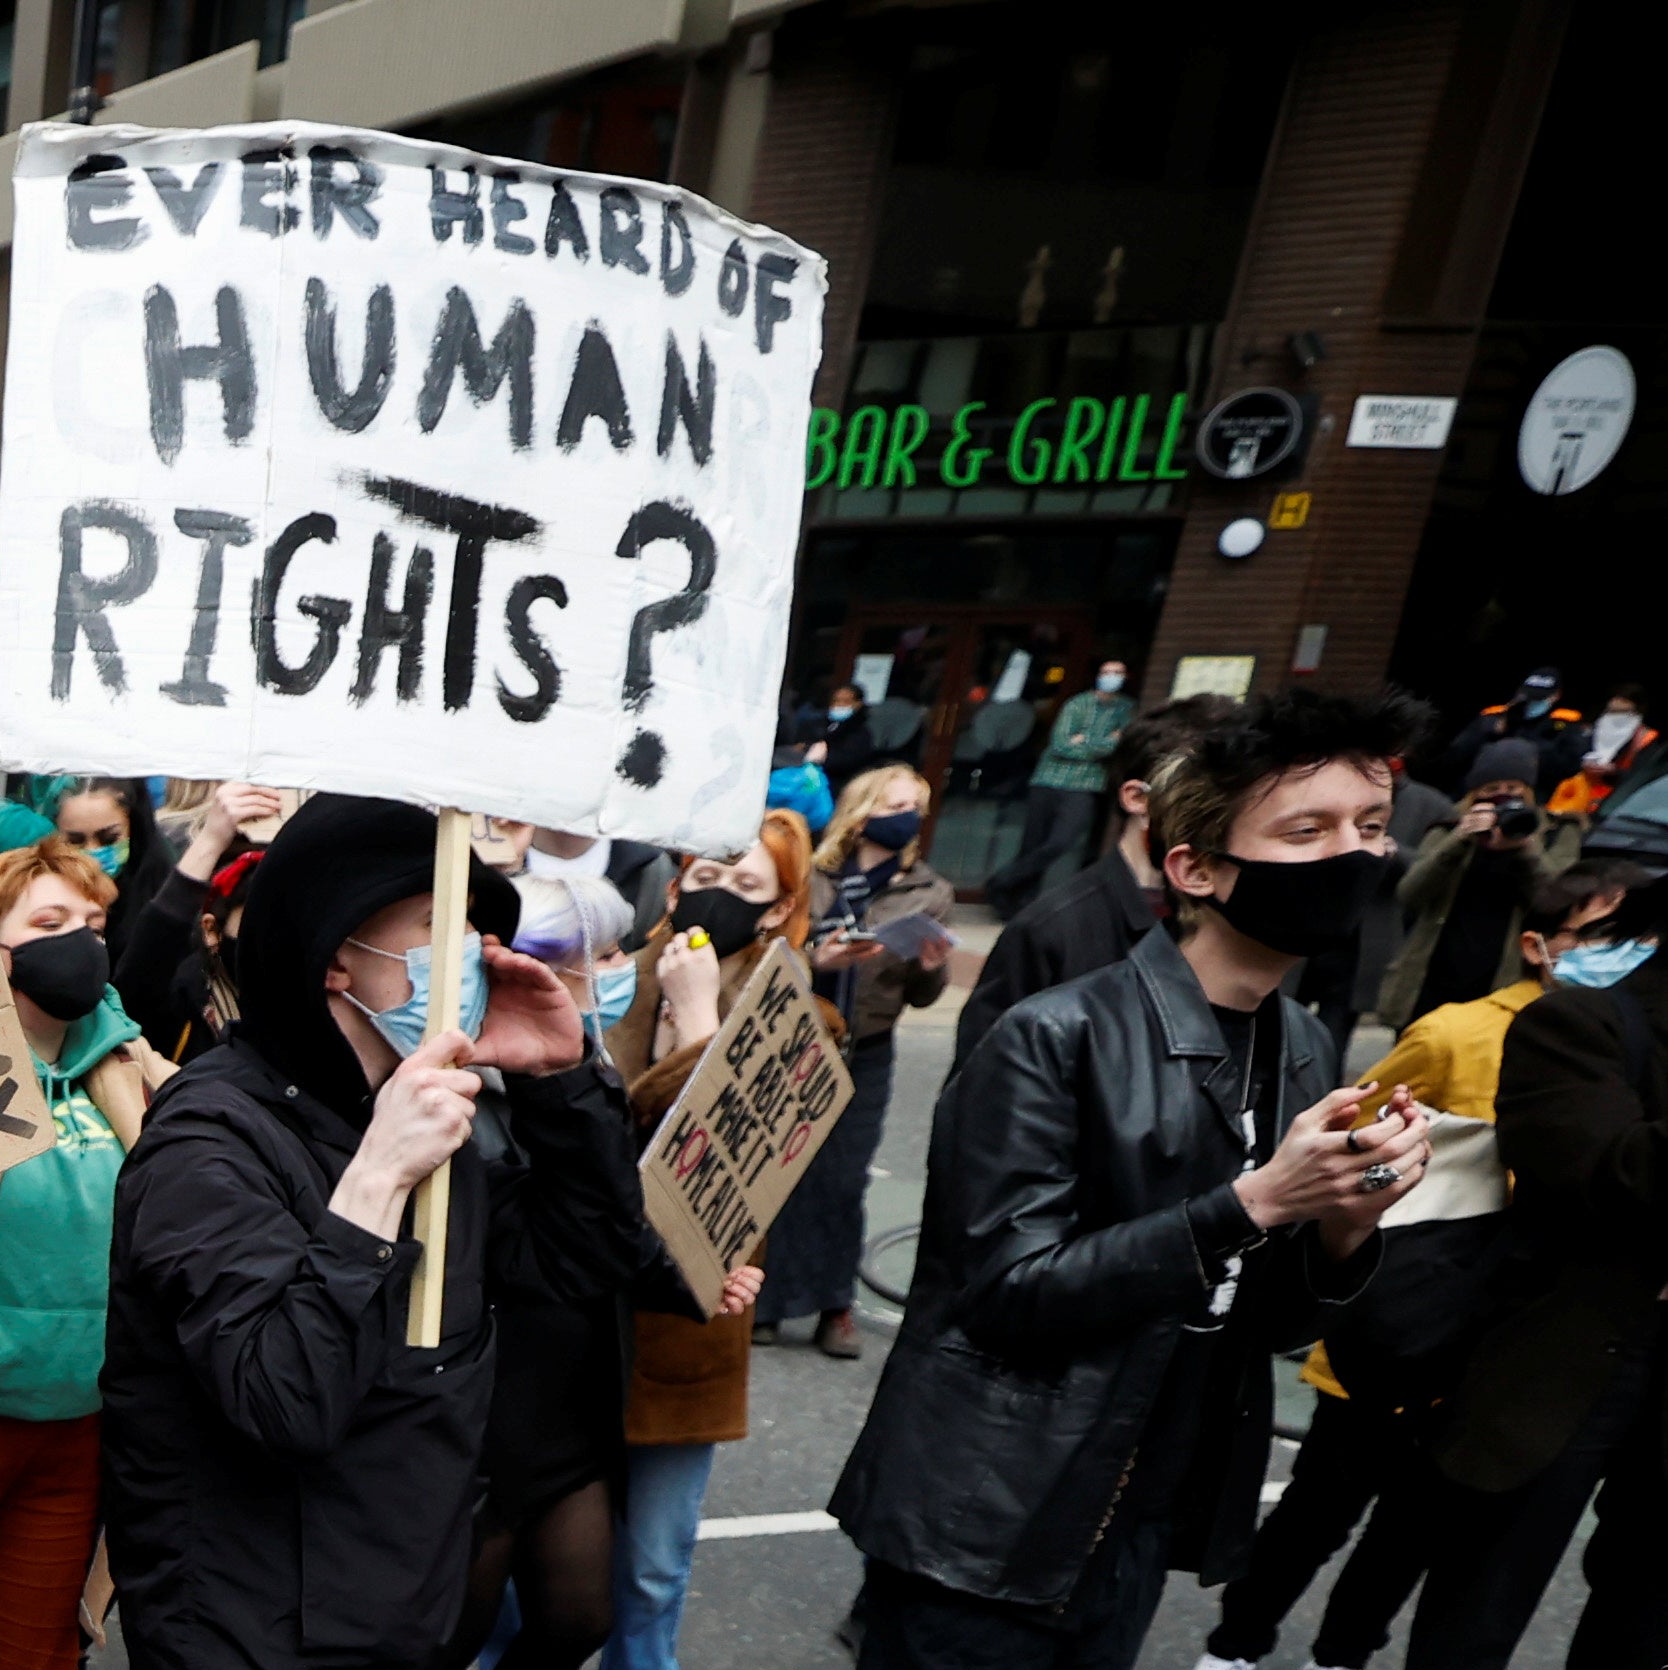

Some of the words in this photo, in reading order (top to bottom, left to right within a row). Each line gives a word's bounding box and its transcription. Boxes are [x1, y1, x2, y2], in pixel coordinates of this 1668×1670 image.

[64, 144, 388, 256] EVER
[426, 163, 696, 299] HEARD
[717, 237, 802, 356] OF
[142, 276, 719, 468] HUMAN
[805, 400, 932, 490] BAR
[941, 398, 993, 488] &
[1006, 392, 1188, 488] GRILL
[725, 1017, 765, 1080] BE
[746, 1057, 790, 1136] ABLE
[778, 1104, 813, 1169] TO
[758, 966, 798, 1034] WE
[779, 1011, 840, 1124] SHOULD
[661, 1110, 727, 1216] HOME
[700, 1175, 759, 1273] ALIVE
[705, 1081, 760, 1164] MAKE
[738, 1133, 778, 1189] IT
